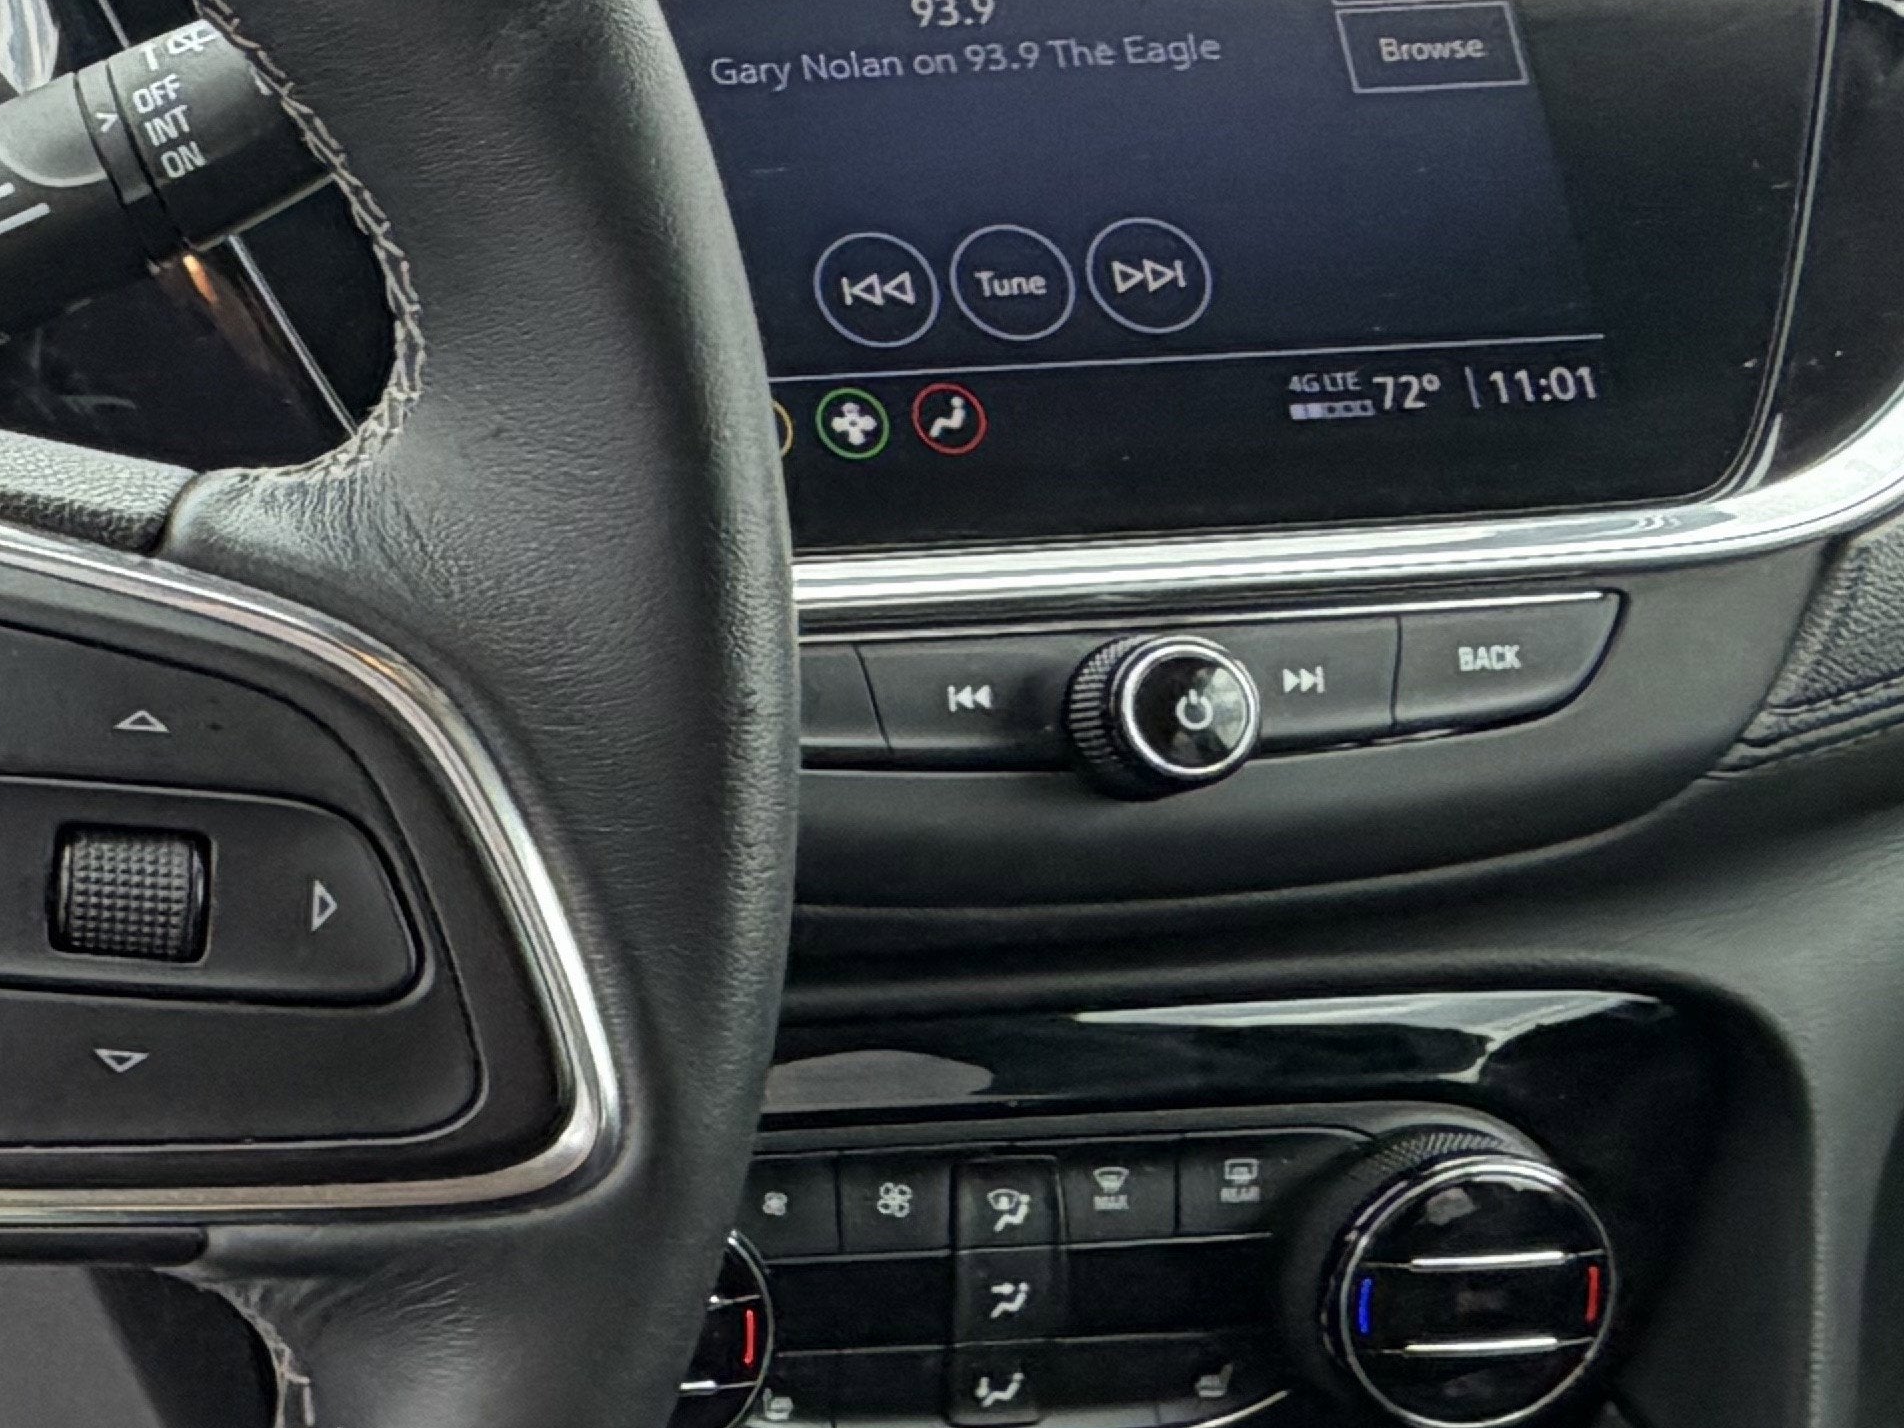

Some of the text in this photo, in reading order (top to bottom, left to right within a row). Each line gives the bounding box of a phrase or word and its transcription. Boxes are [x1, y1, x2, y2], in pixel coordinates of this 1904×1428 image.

[709, 32, 1222, 92] Gary Nolan on 93.9 The Eagle
[1379, 37, 1487, 63] Browse
[132, 73, 181, 113] OFF
[144, 104, 190, 147] INT
[160, 140, 207, 180] ON
[975, 269, 1047, 299] Tune
[1287, 371, 1362, 393] 4G LTE
[1490, 366, 1598, 404] 11:01
[1458, 644, 1523, 672] BACK
